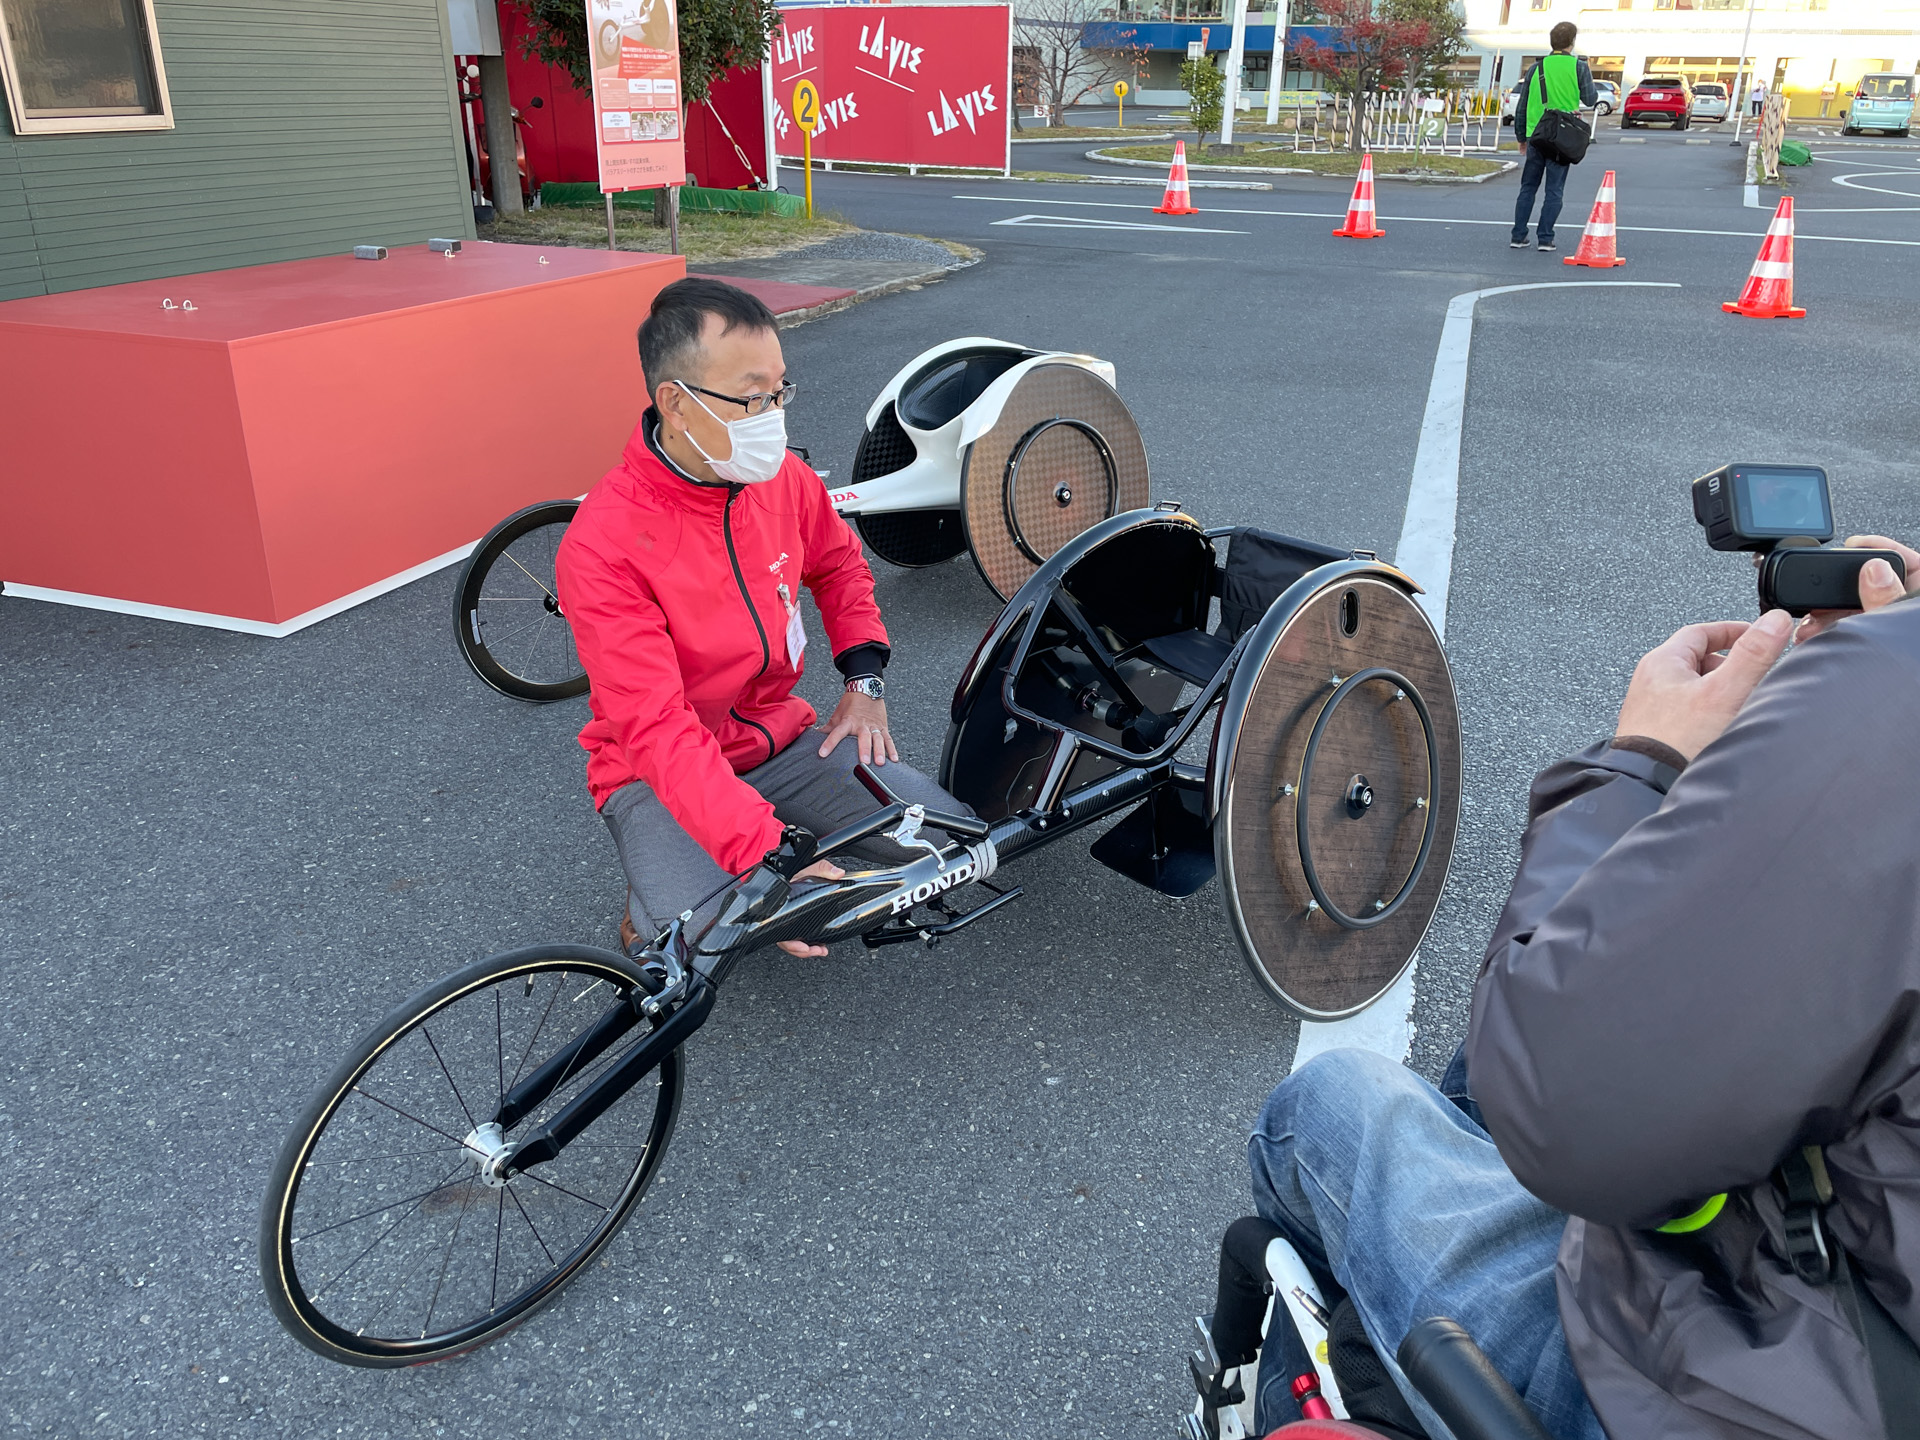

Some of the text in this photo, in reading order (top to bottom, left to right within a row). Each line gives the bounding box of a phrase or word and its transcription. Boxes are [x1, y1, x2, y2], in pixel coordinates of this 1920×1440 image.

[1117, 83, 1123, 95] 1
[800, 86, 814, 123] 2
[1426, 120, 1439, 136] 2
[1708, 476, 1720, 492] 9
[889, 863, 976, 916] HOND
